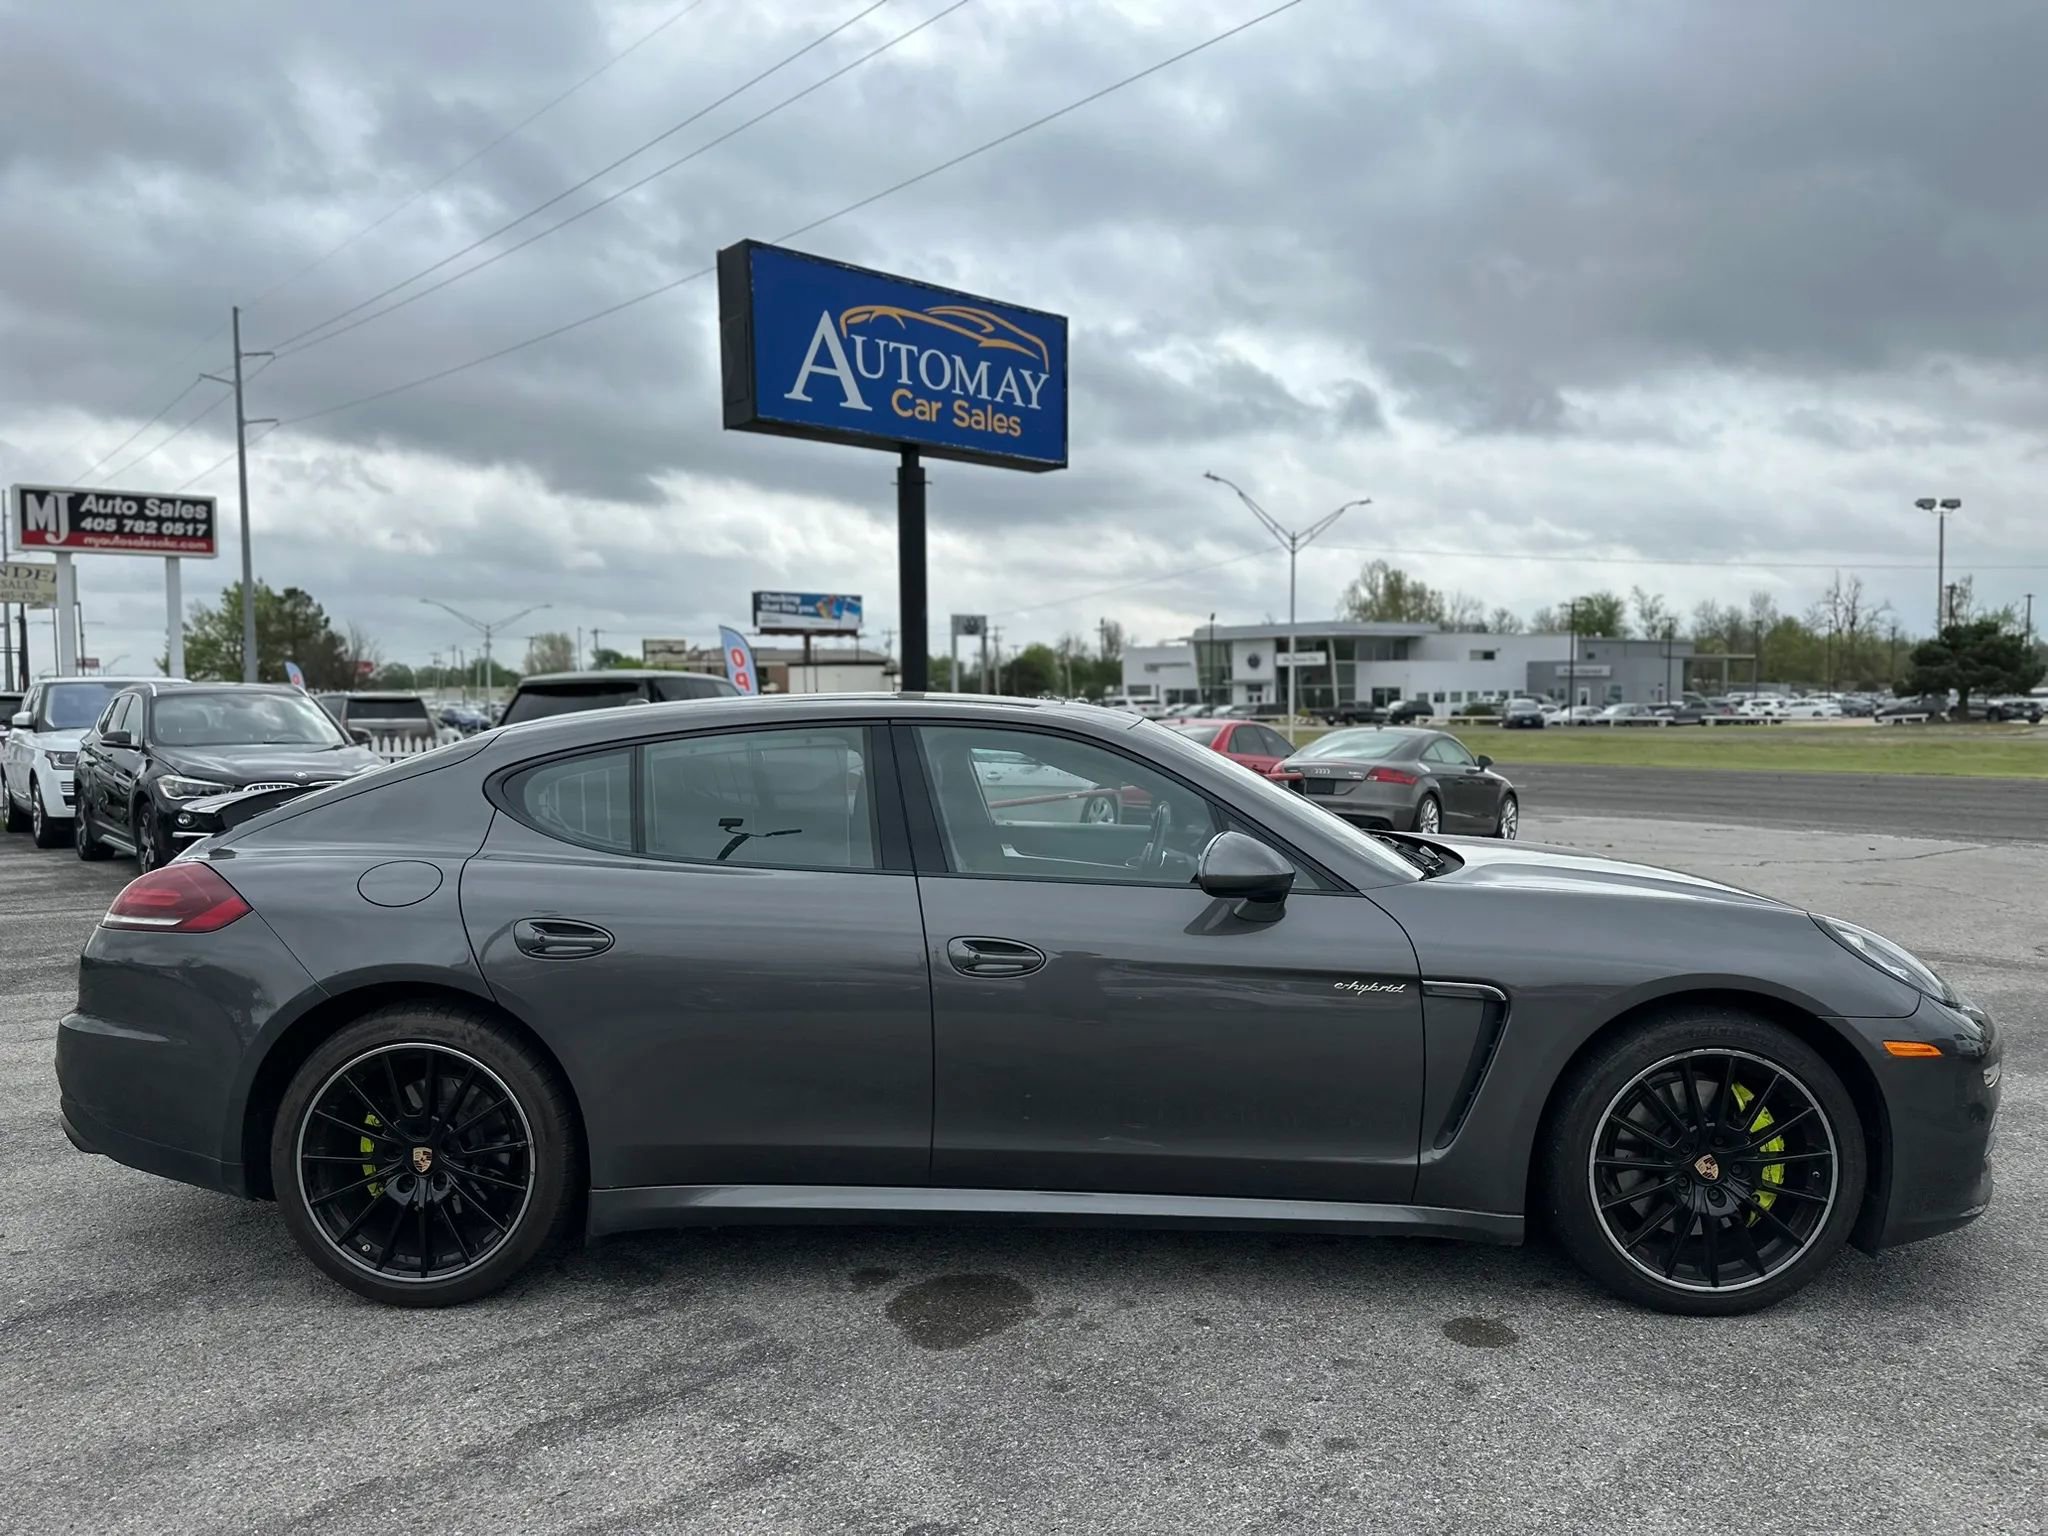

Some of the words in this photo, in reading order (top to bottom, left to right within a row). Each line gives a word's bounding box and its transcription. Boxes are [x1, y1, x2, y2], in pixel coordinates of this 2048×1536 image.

[891, 389, 943, 423] Car
[953, 400, 1022, 437] Sales
[26, 491, 75, 544] MJ
[80, 494, 138, 515] Auto
[144, 498, 208, 519] Sales
[81, 517, 117, 532] 405
[122, 519, 158, 534] 782
[161, 522, 208, 537] 0517
